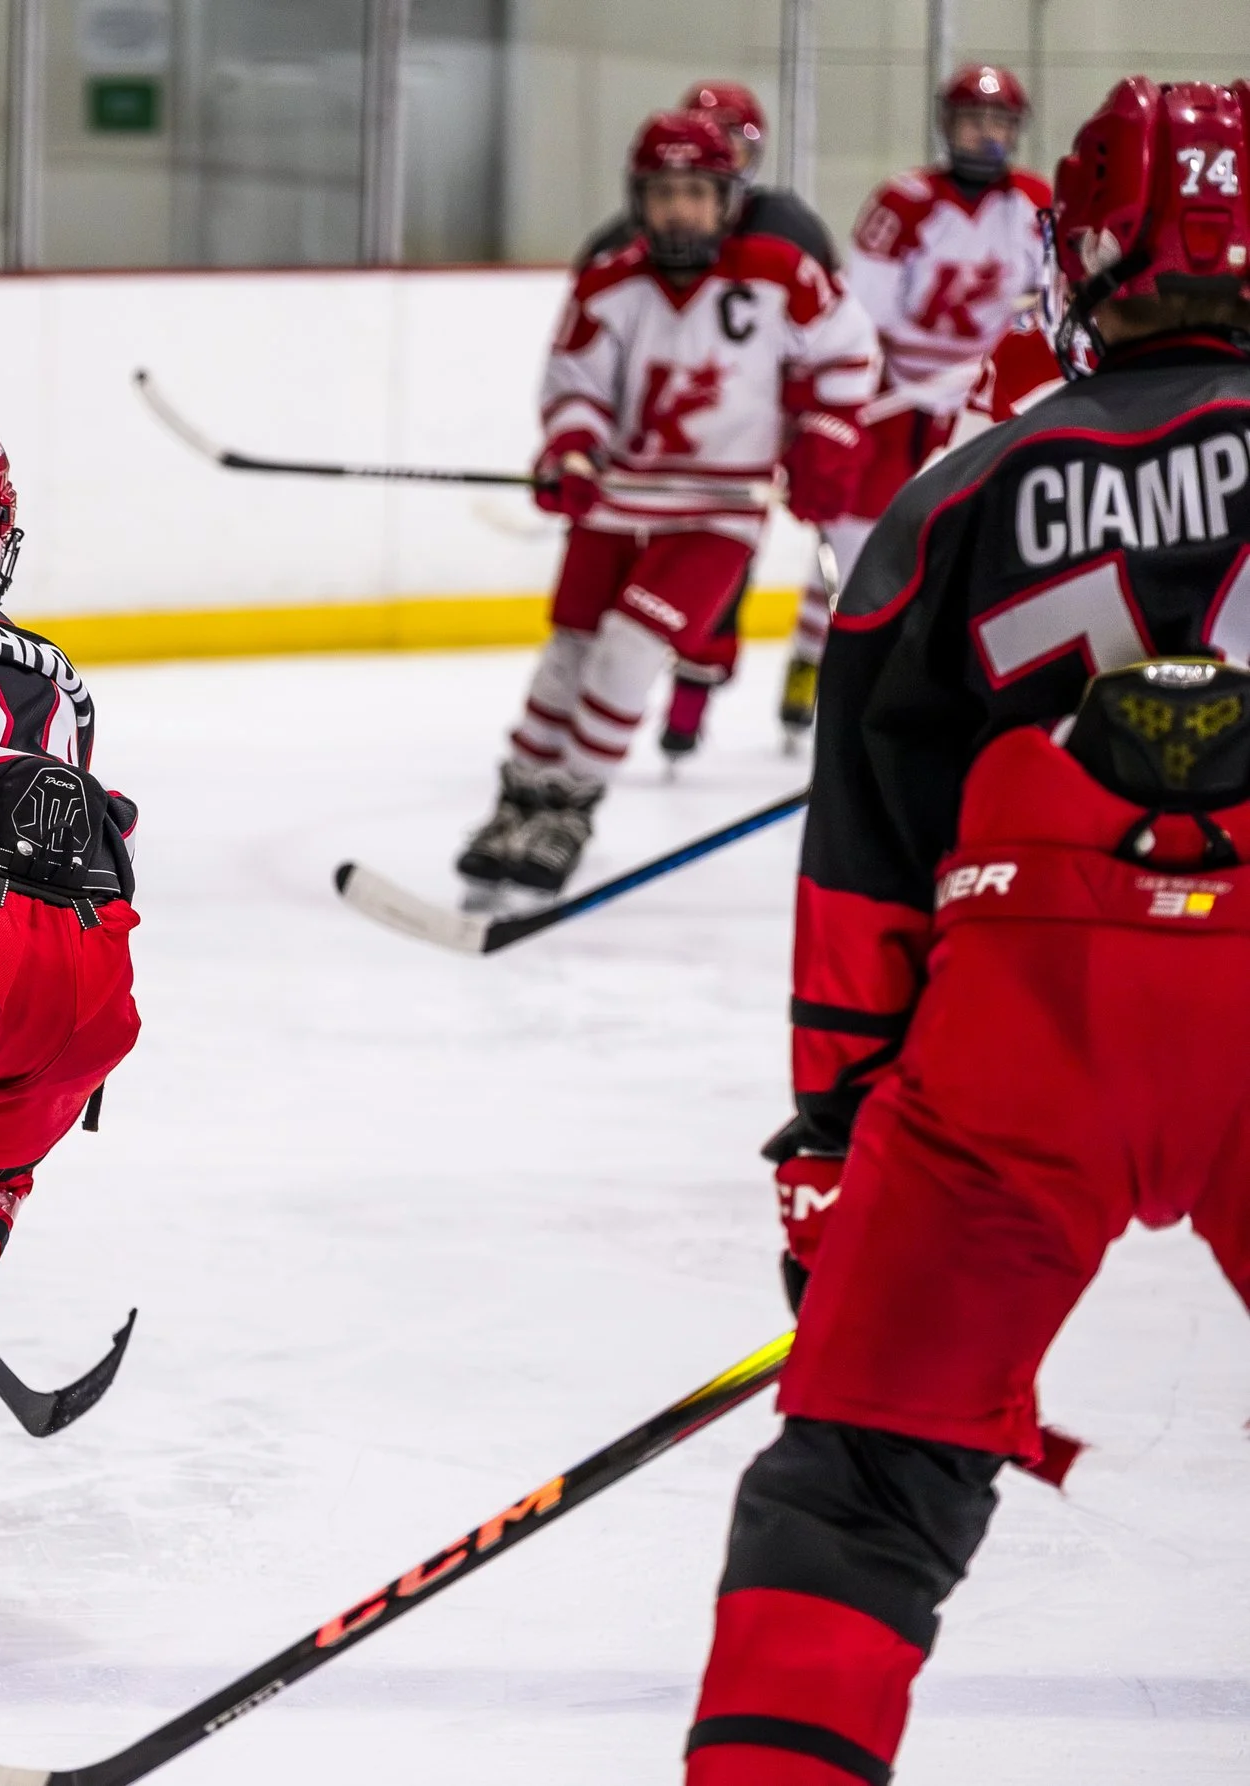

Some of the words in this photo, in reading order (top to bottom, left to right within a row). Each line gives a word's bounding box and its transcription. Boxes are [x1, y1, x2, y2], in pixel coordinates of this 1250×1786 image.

[1177, 148, 1238, 195] 74
[718, 286, 754, 341] C
[44, 775, 76, 790] TACKS
